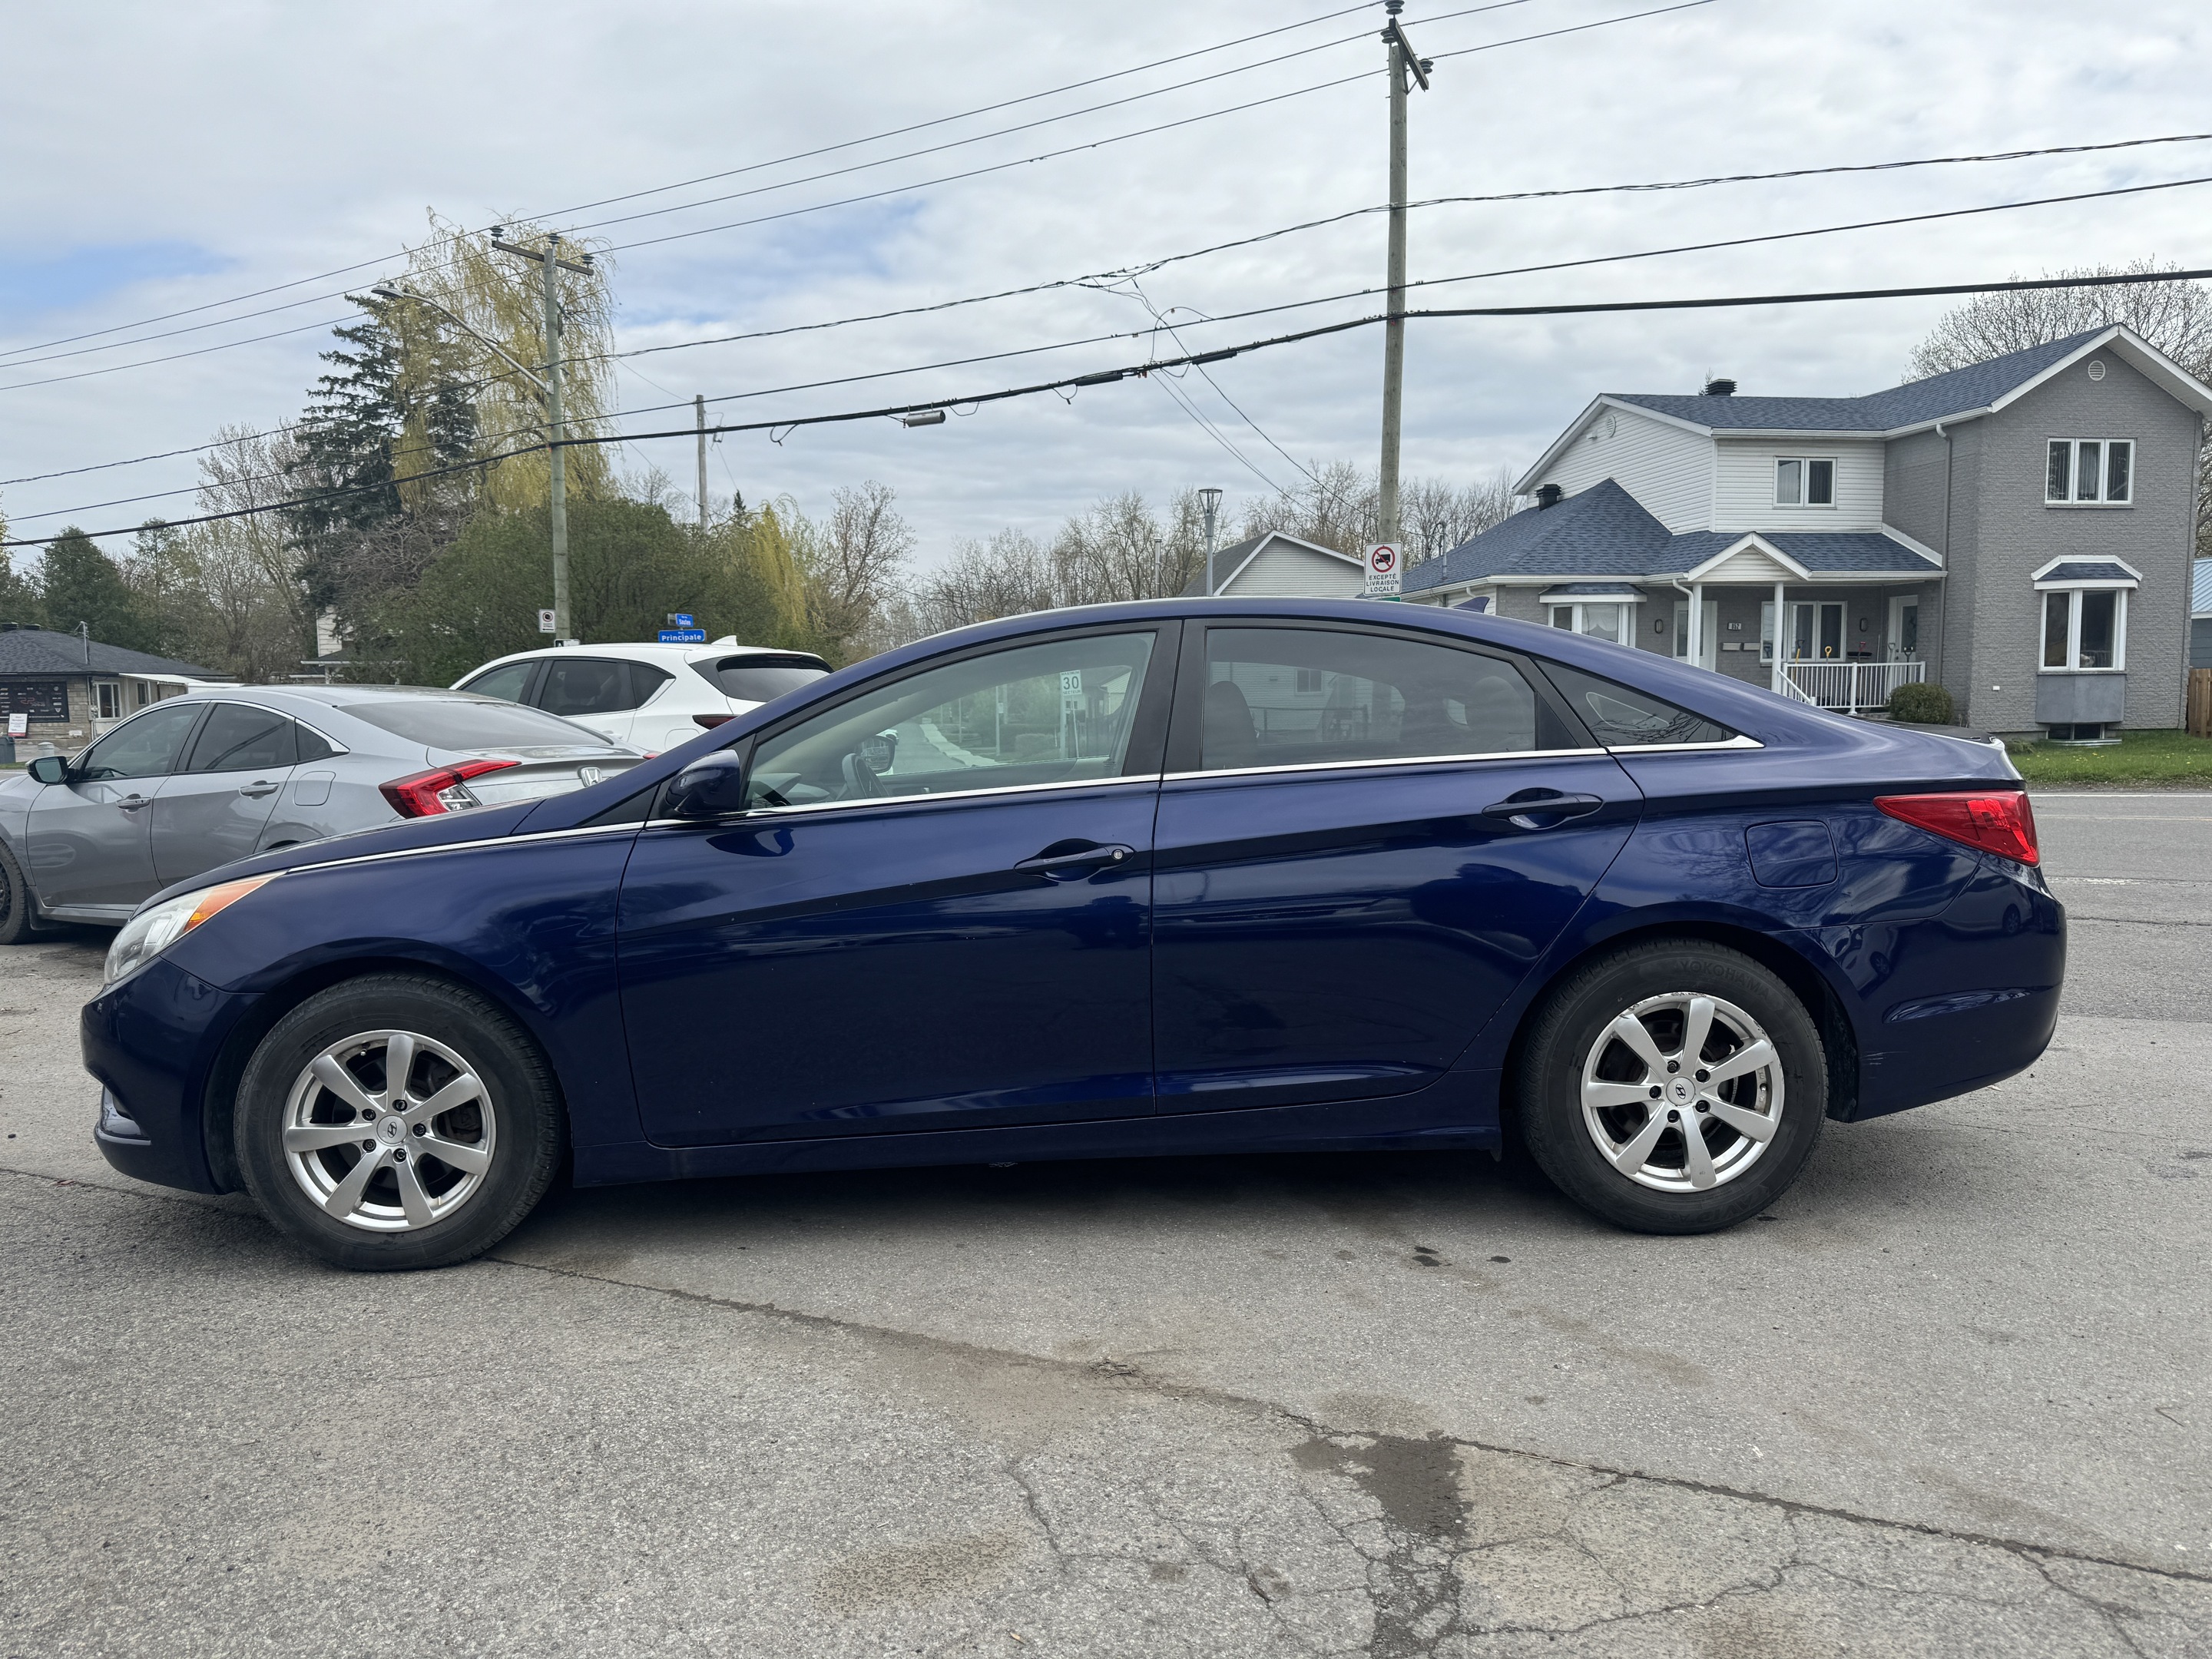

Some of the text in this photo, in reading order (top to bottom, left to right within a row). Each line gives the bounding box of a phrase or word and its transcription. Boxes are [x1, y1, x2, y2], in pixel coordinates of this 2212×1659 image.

[661, 634, 702, 642] Principale
[1063, 676, 1079, 690] 30
[1680, 960, 1771, 998] YOKOHAMA
